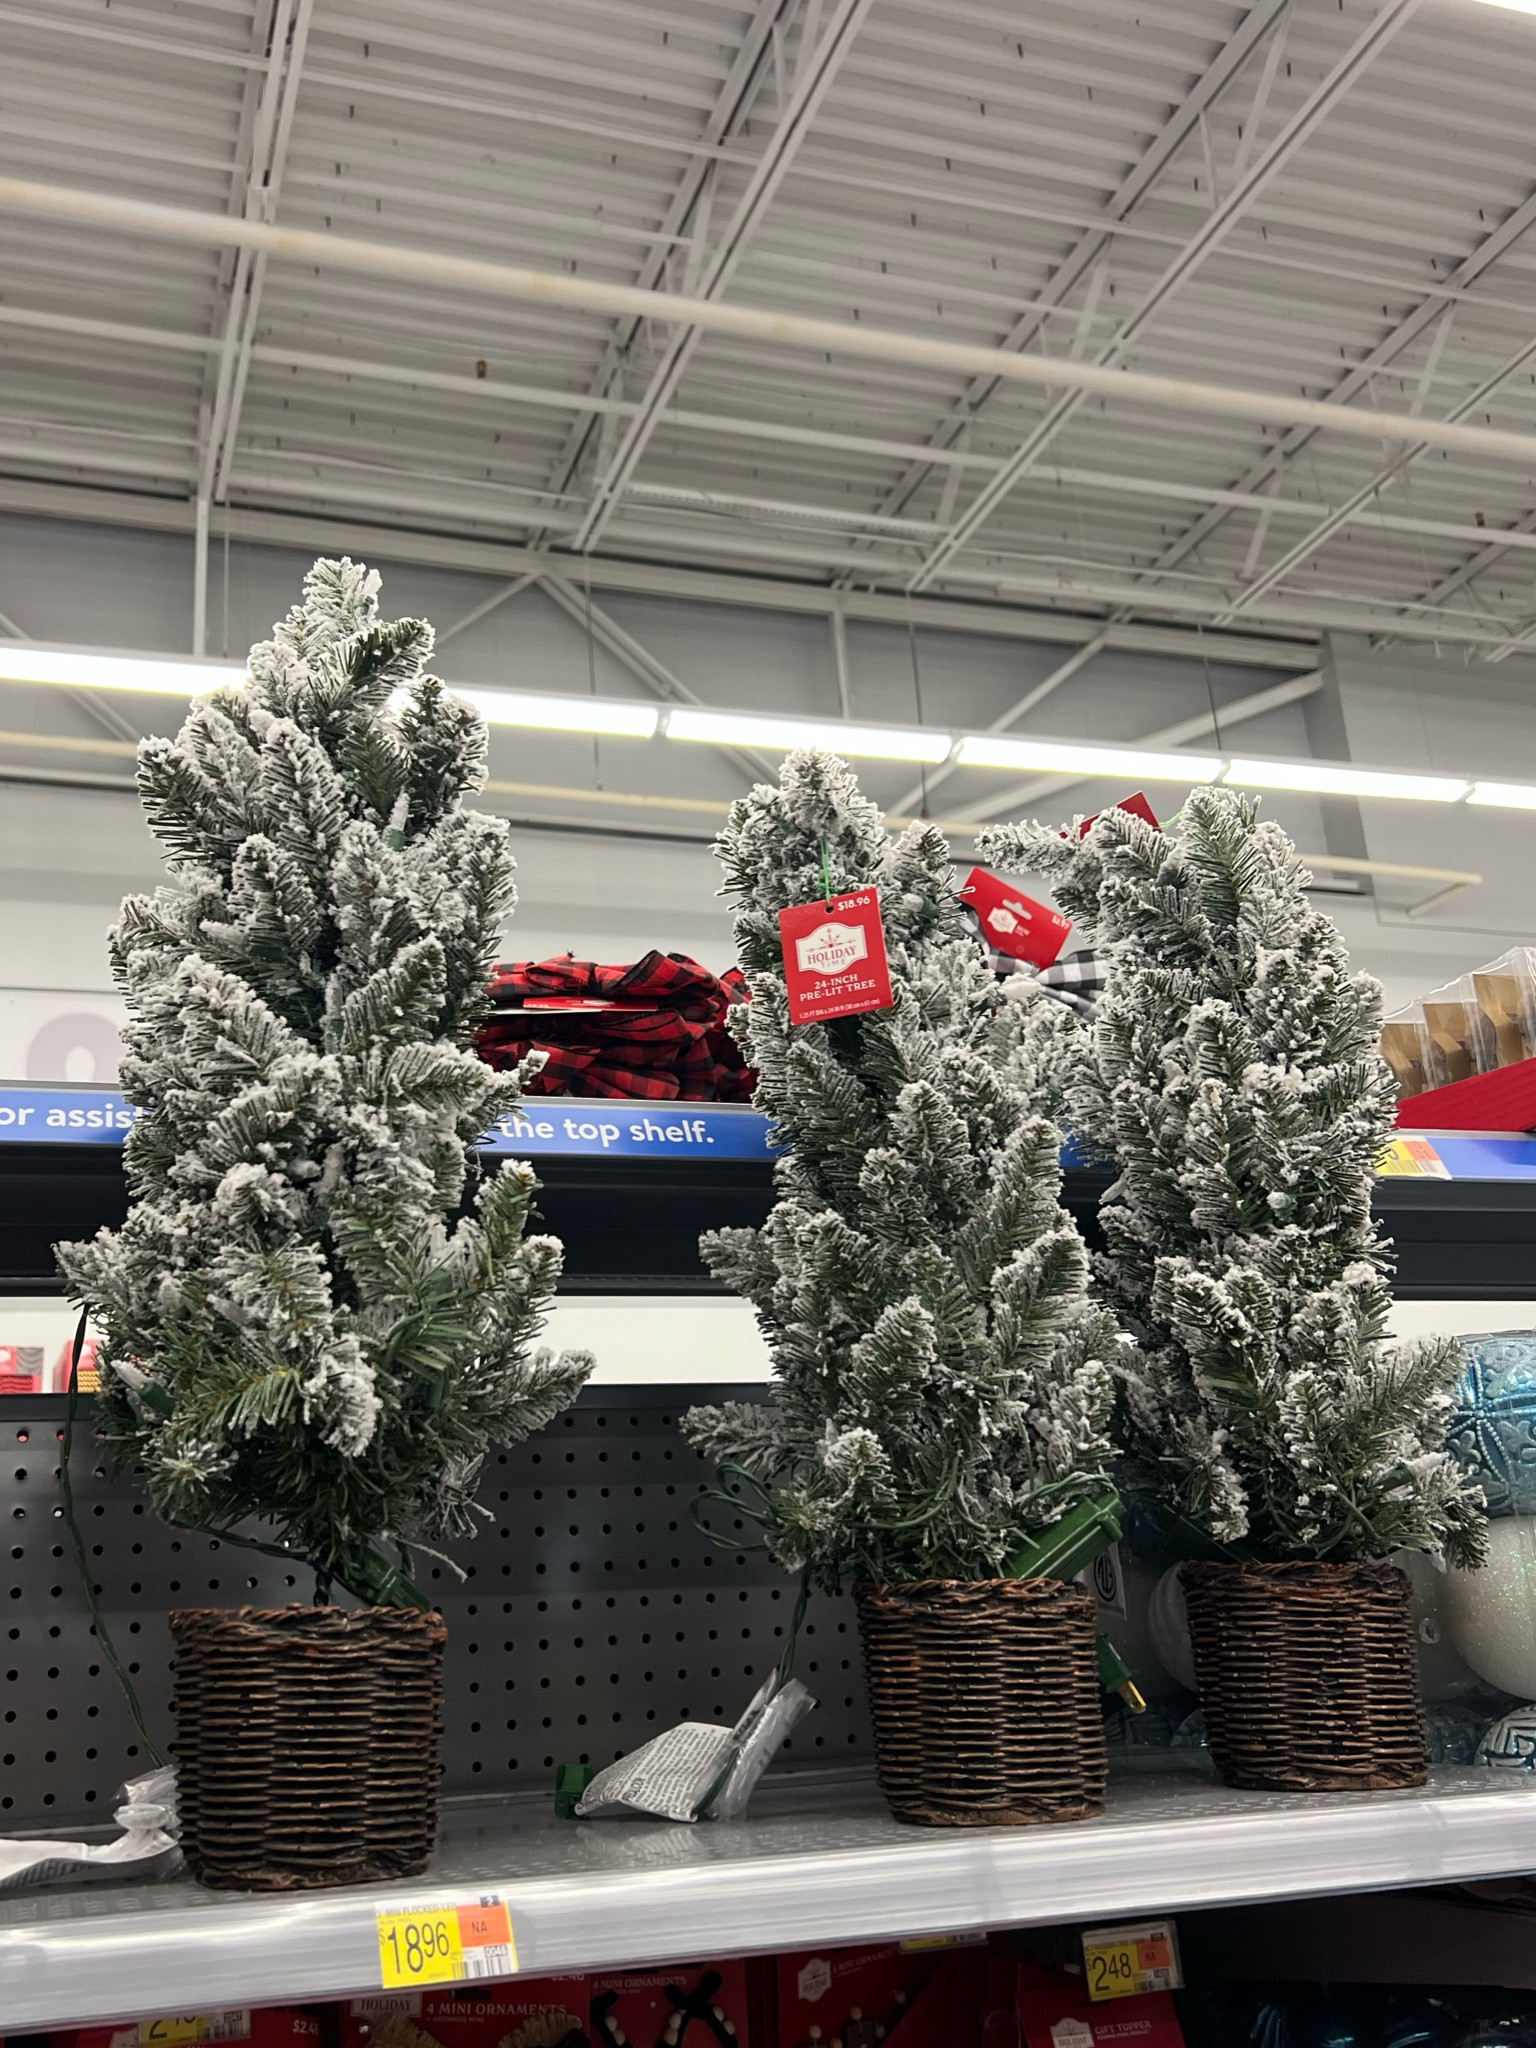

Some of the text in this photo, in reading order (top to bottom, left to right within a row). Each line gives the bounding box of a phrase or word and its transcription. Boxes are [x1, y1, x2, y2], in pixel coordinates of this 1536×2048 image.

[837, 896, 871, 911] $18.96
[807, 946, 856, 965] HOLIDAY
[821, 958, 847, 969] TIME
[814, 974, 858, 989] 24-INCH
[799, 979, 876, 1002] PRE-LIT TREE
[498, 1116, 715, 1147] the top shelf.
[471, 1921, 488, 1935] NA
[1145, 1951, 1157, 1962] NA
[624, 1975, 688, 1988] ORNAMENTS
[360, 1998, 411, 2013] HOLIDAY
[426, 2003, 567, 2015] 4 MINI ORNAMENTS
[1095, 2024, 1116, 2035] GIFT
[1116, 2019, 1152, 2032] TOPPER
